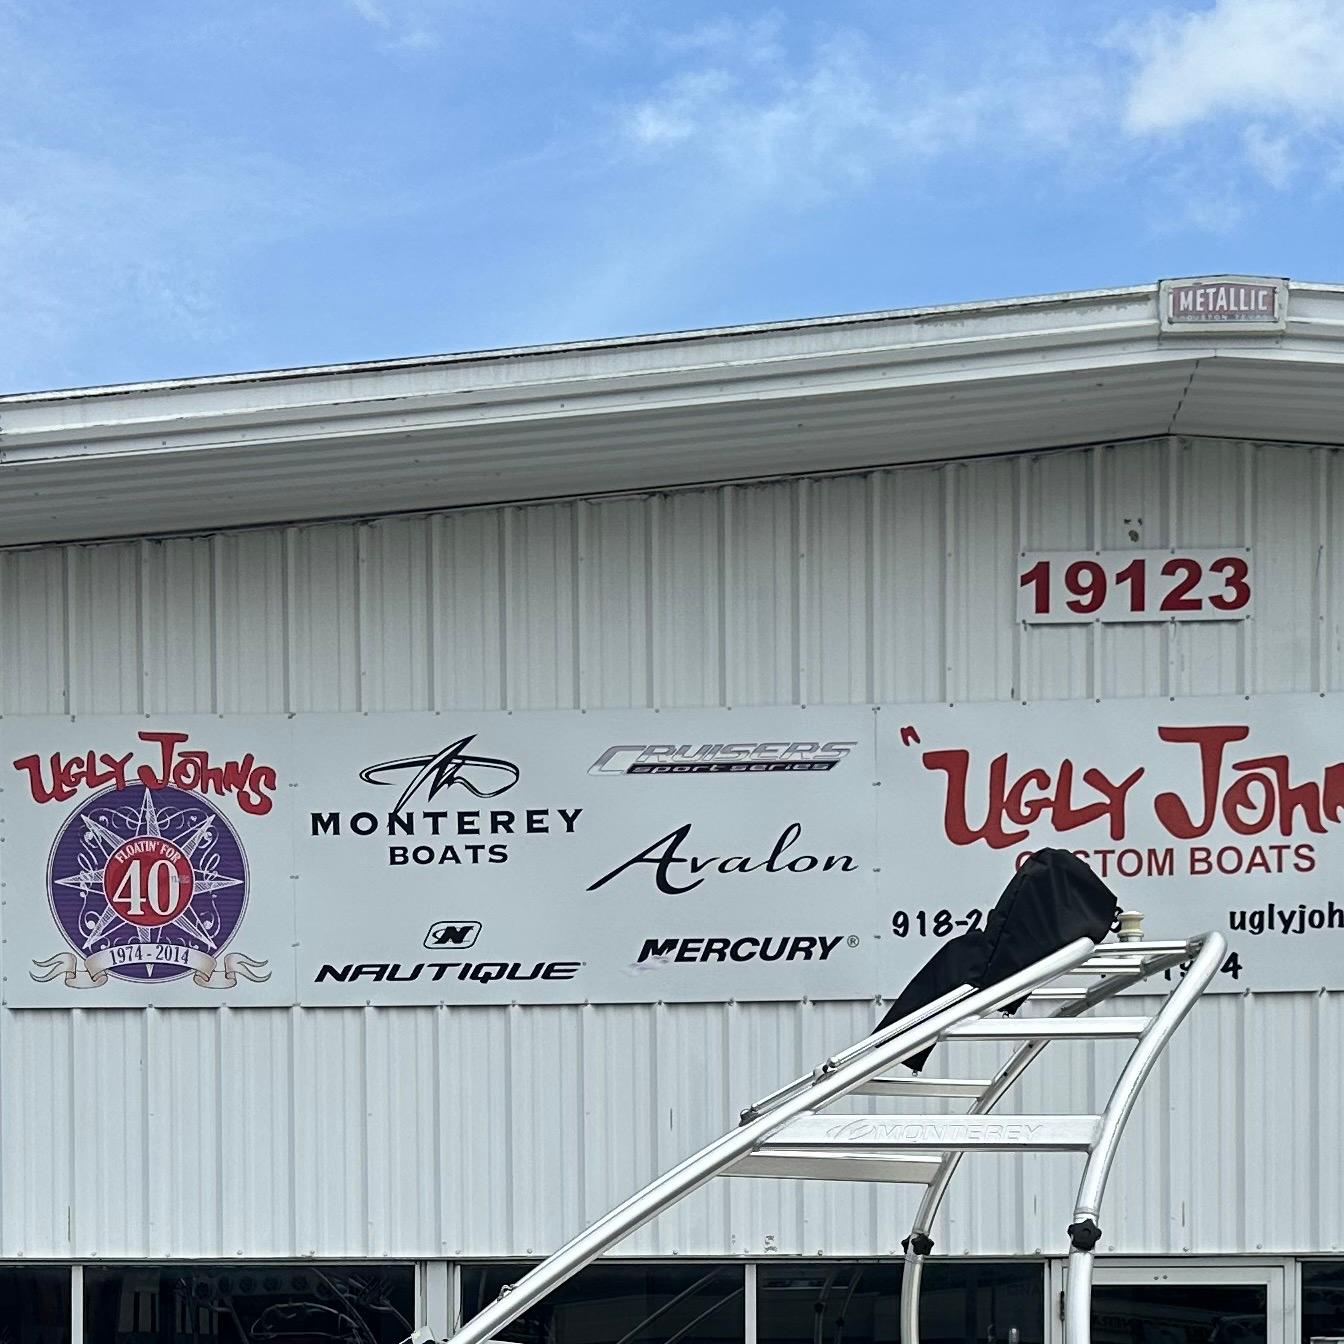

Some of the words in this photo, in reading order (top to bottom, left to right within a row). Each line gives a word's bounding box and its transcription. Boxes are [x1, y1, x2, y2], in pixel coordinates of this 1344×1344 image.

[1180, 287, 1267, 311] METALLIC
[1020, 557, 1251, 614] 19123
[586, 741, 858, 777] CRUISERS
[631, 763, 718, 774] sport
[728, 761, 829, 772] series
[311, 808, 583, 836] MONTEREY
[160, 844, 182, 863] FOR
[389, 844, 509, 866] BOATS
[586, 822, 859, 895] Avalon
[1015, 847, 1175, 877] TOM
[1190, 843, 1316, 876] BOATS
[112, 859, 180, 916] 40
[110, 946, 142, 966] 1974
[156, 944, 190, 965] 2014
[314, 961, 582, 984] NAUTIQUE
[875, 1124, 1044, 1141] MONTEREY
